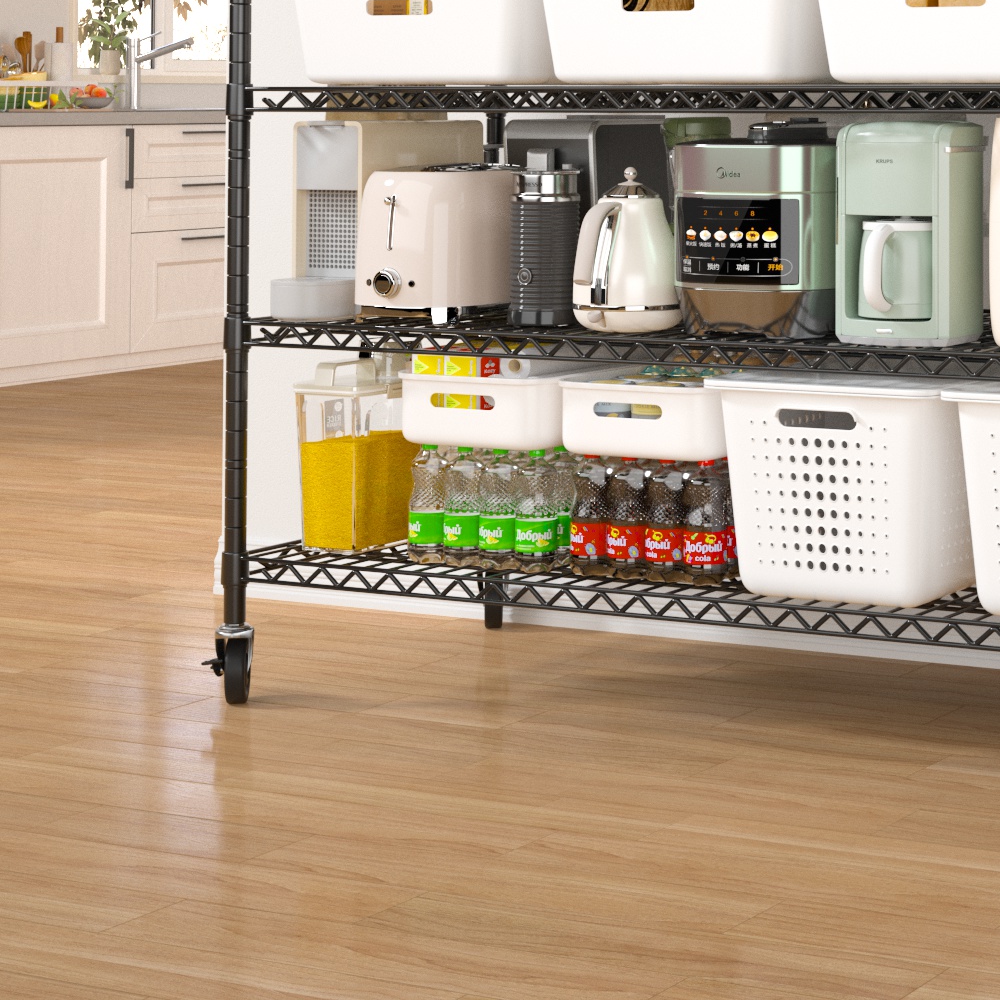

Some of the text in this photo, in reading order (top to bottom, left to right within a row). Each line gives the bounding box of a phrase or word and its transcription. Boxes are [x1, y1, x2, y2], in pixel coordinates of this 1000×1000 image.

[516, 529, 553, 542] Добрый
[686, 540, 724, 554] Добрый
[695, 554, 711, 562] cola
